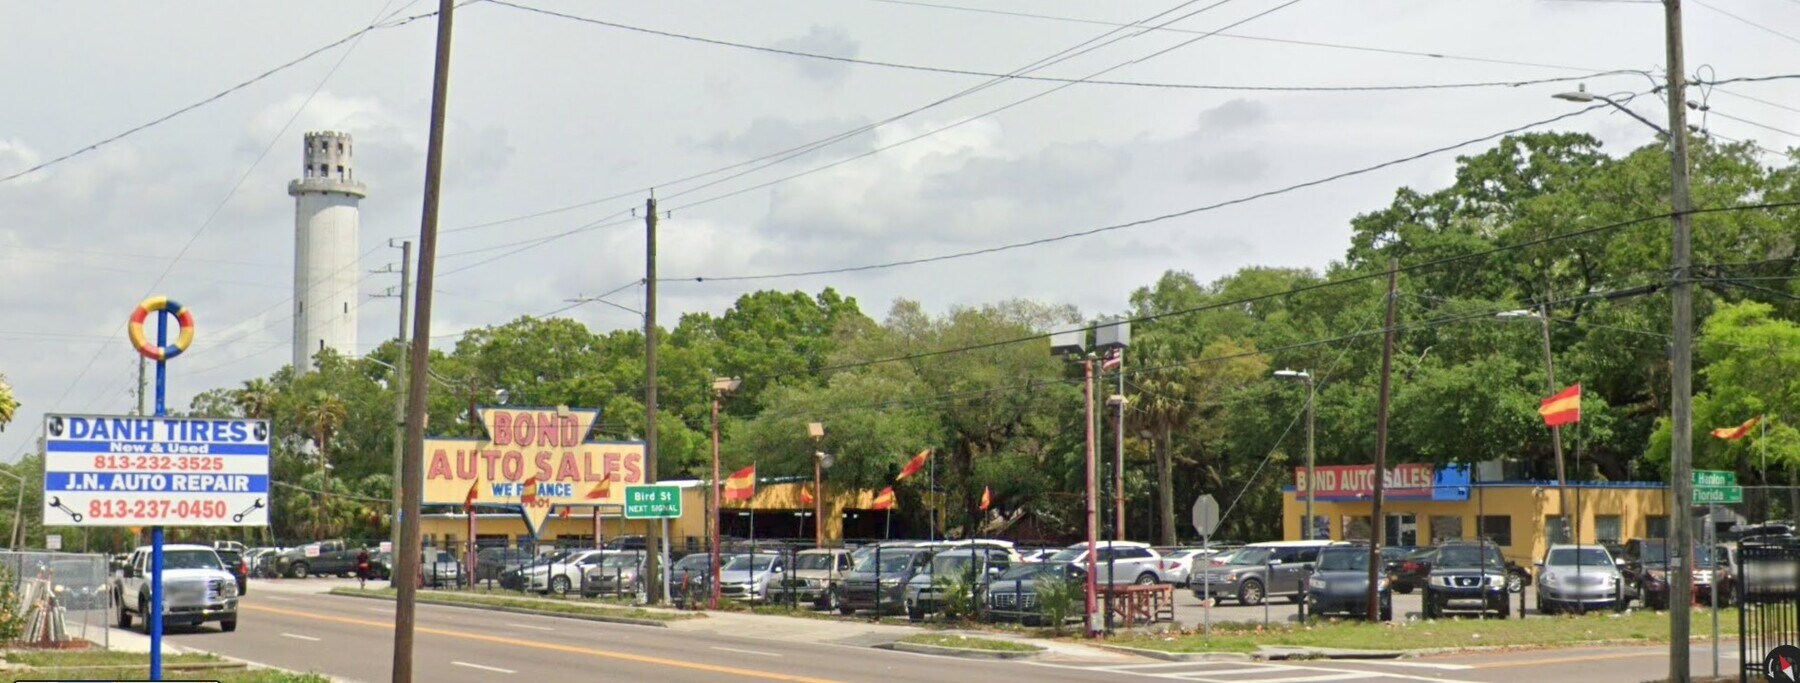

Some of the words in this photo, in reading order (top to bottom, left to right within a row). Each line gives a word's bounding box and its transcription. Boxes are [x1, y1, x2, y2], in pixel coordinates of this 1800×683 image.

[69, 416, 154, 440] DANH
[163, 420, 248, 442] TIRES
[493, 411, 579, 447] BOND
[110, 442, 146, 452] New
[150, 443, 164, 453] &
[167, 443, 209, 454] Used
[94, 455, 224, 470] 813-232-3525
[427, 449, 525, 481] AUTO
[534, 450, 642, 483] SALES
[65, 474, 105, 490] J.N.
[110, 474, 167, 490] AUTO
[171, 475, 249, 491] REPAIR
[1383, 467, 1431, 489] SALES
[492, 483, 513, 496] WE
[516, 483, 572, 496] FANCE
[634, 491, 656, 501] Bird
[660, 491, 672, 501] St
[1692, 488, 1724, 501] Florida
[89, 500, 227, 518] 813-237-0450
[628, 504, 648, 512] NEXT
